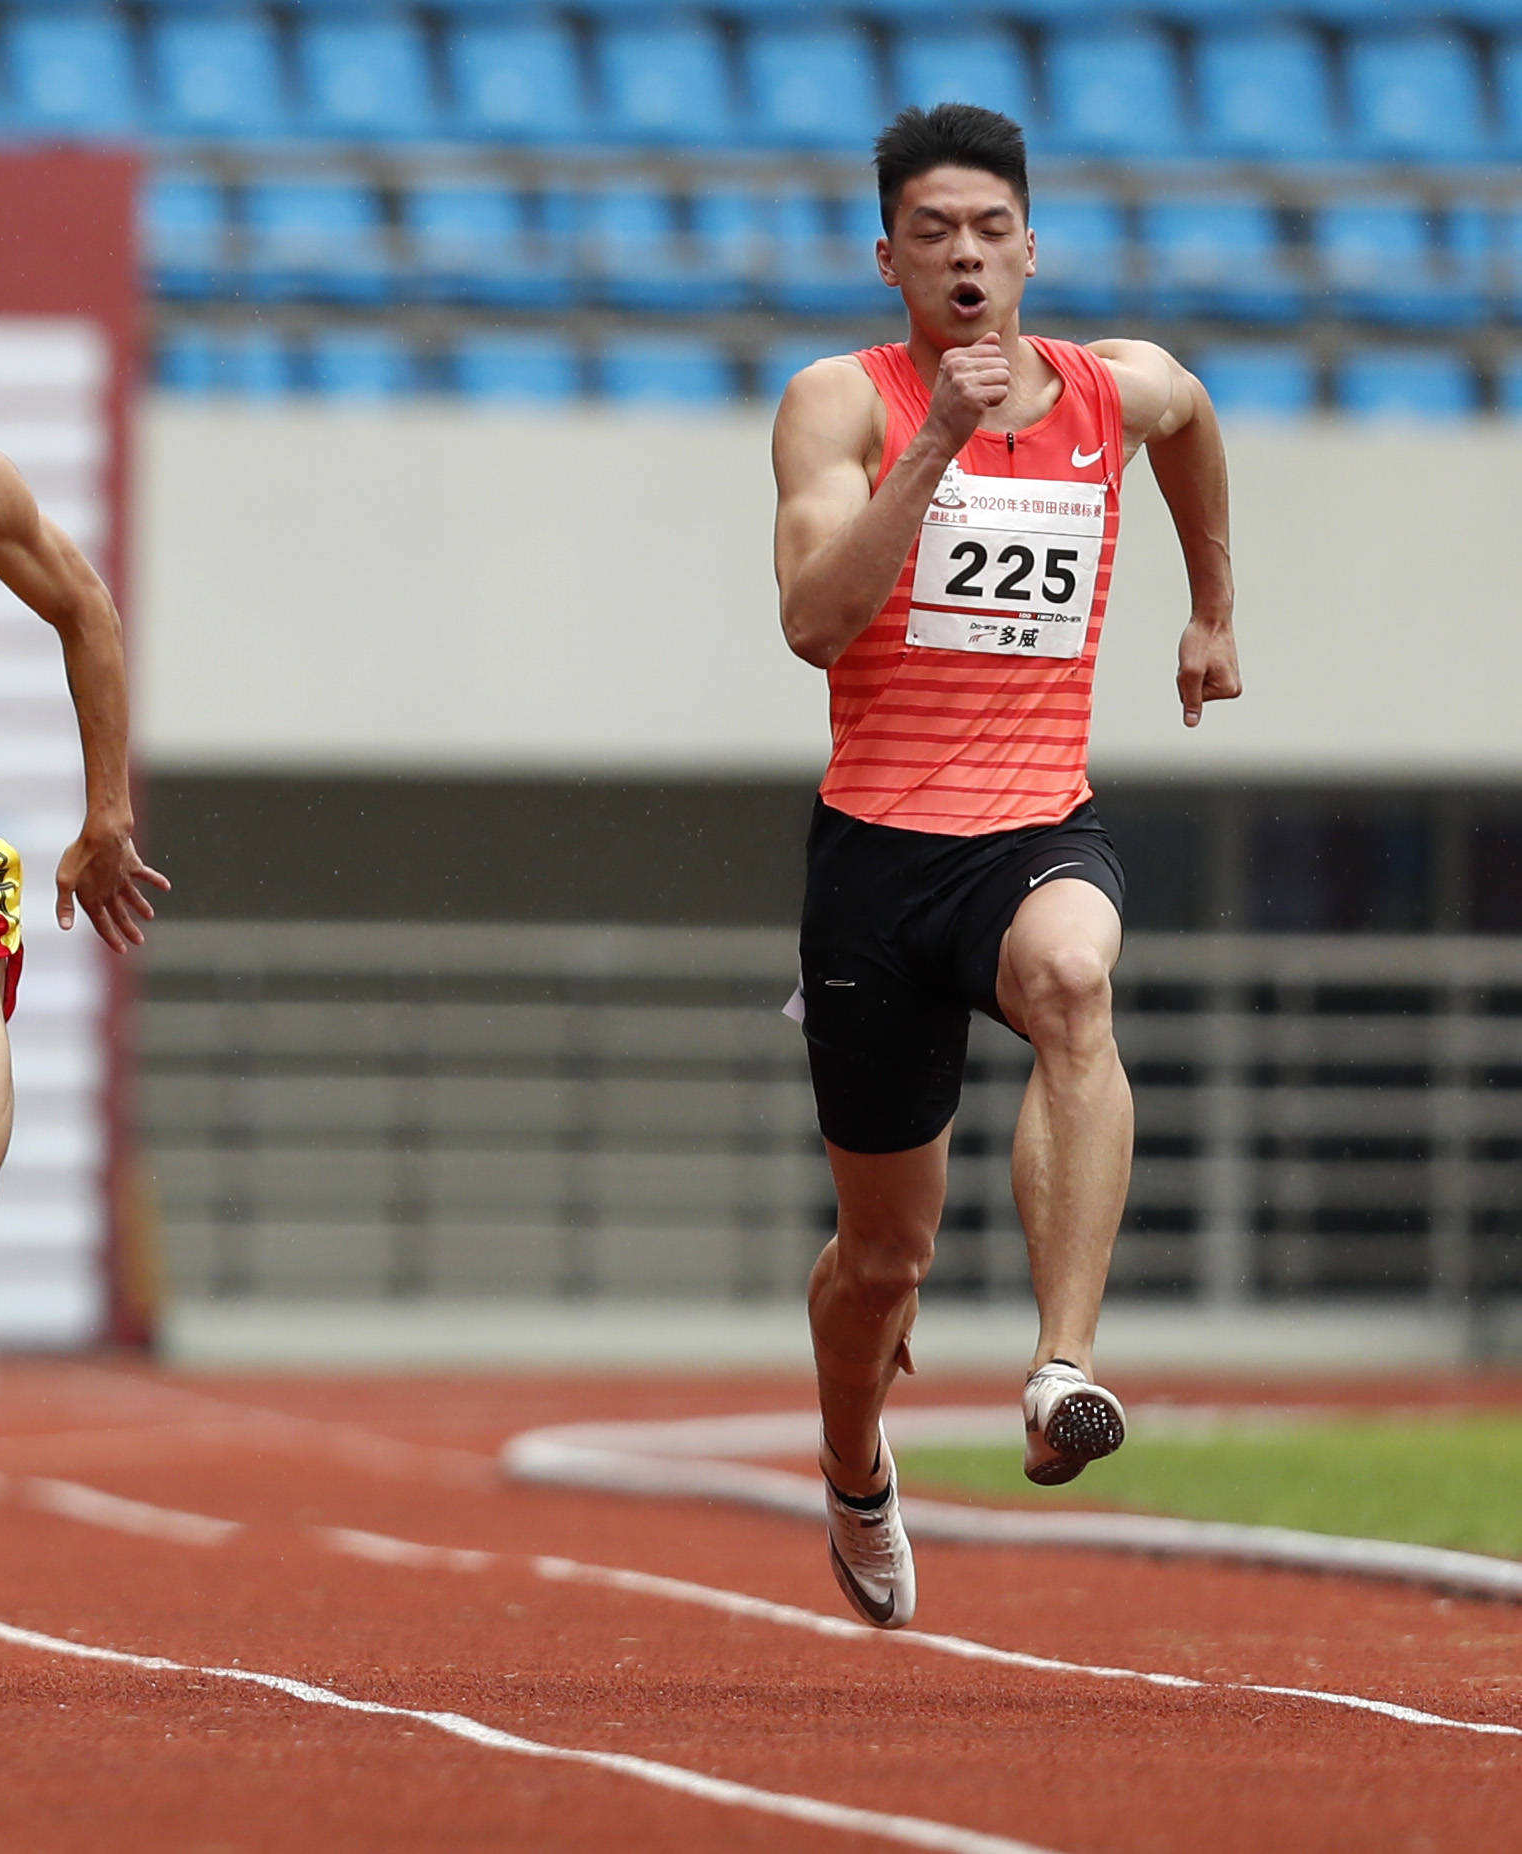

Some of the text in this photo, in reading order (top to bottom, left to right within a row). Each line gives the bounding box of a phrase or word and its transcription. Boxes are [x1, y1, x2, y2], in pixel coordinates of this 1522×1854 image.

[970, 495, 1102, 518] 2020年全国田径锦标赛
[945, 541, 1078, 604] 225
[997, 625, 1039, 648] 多威
